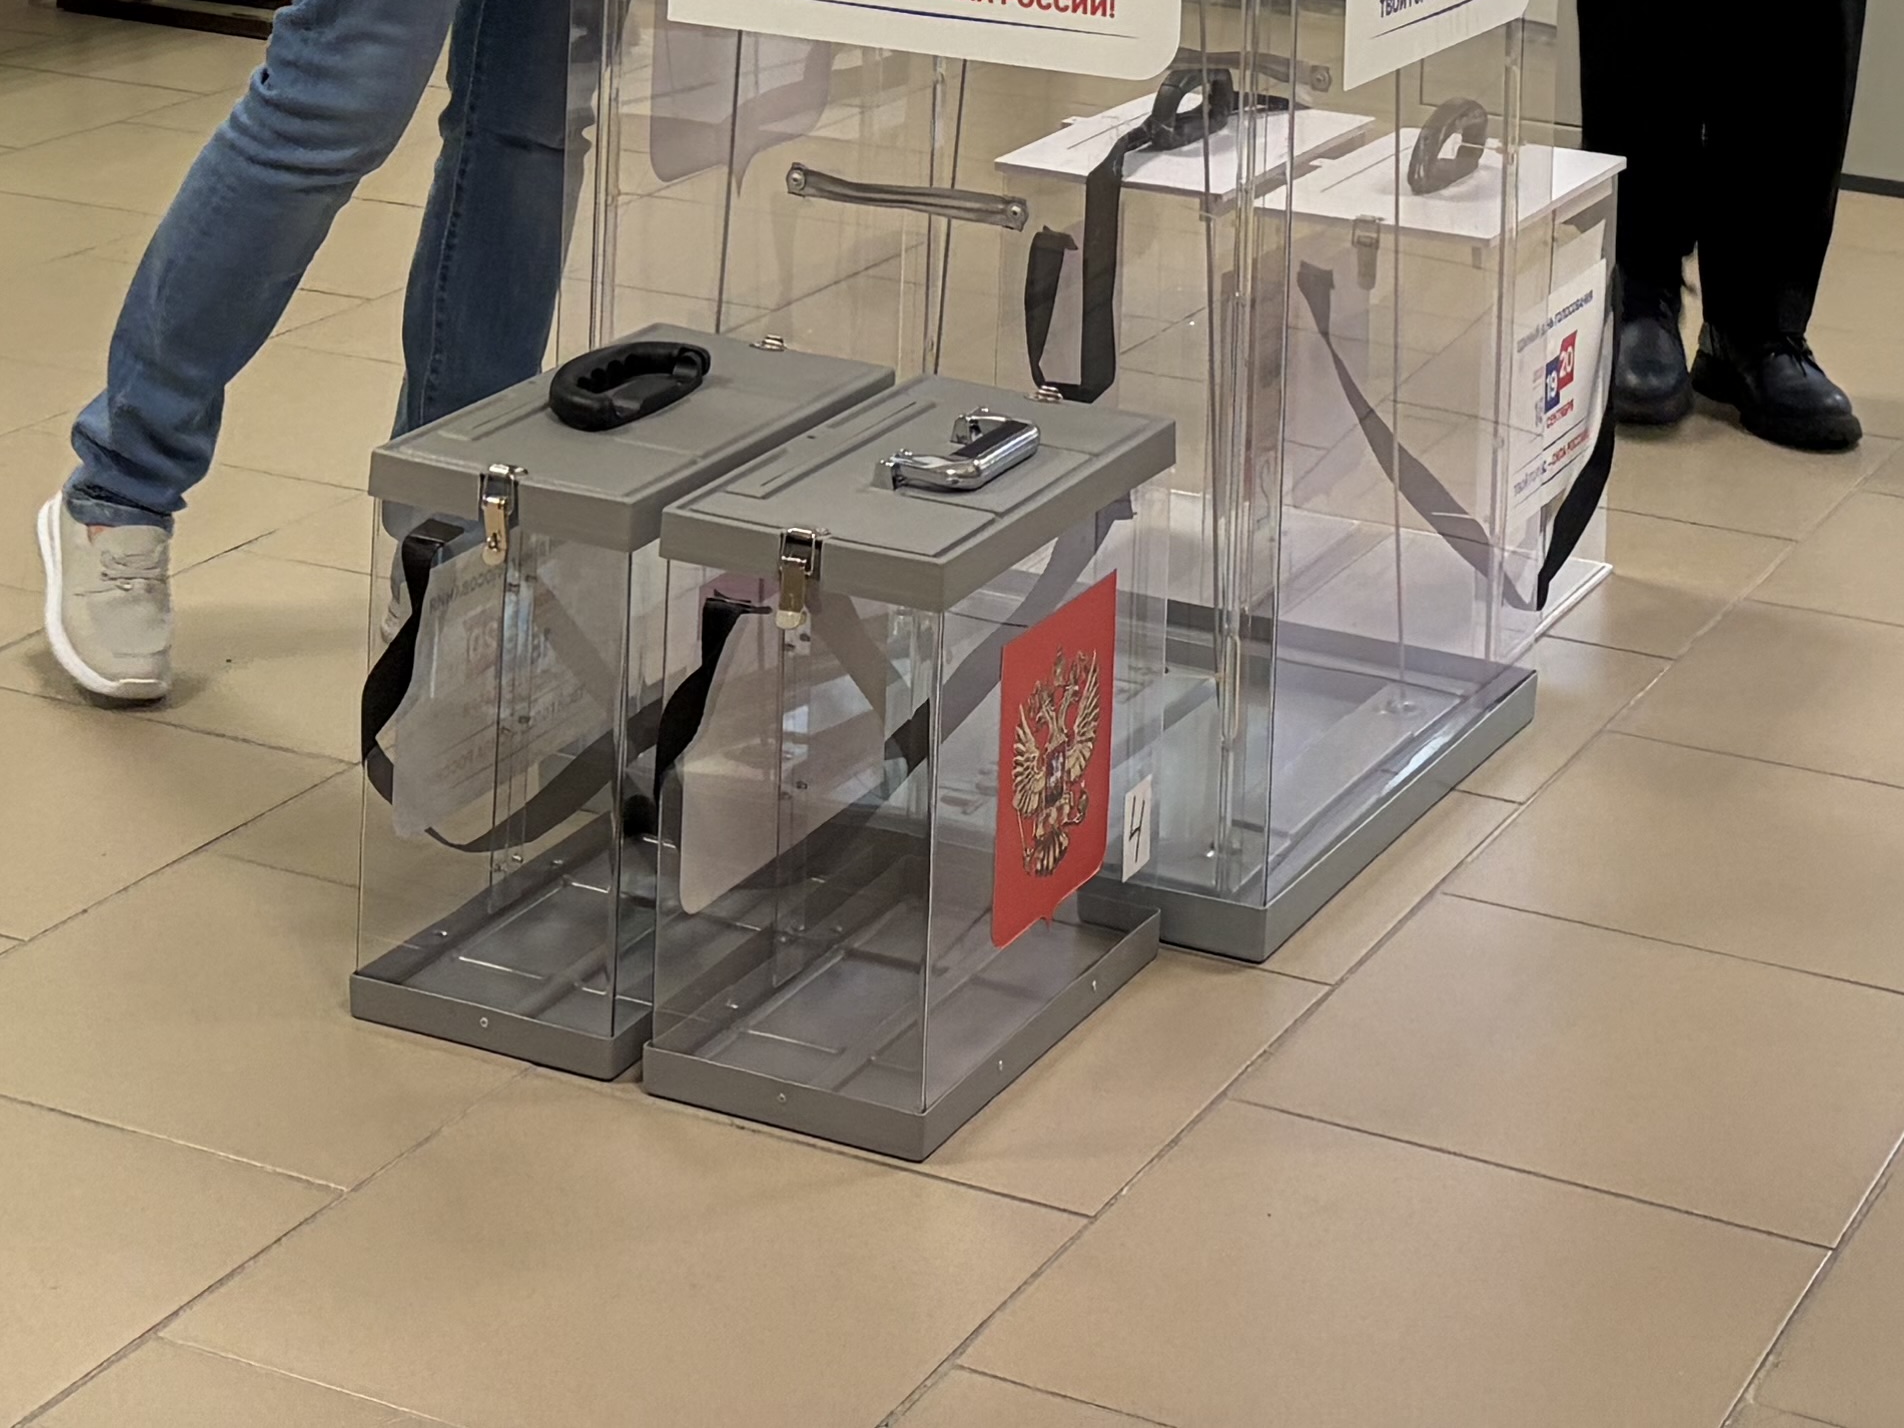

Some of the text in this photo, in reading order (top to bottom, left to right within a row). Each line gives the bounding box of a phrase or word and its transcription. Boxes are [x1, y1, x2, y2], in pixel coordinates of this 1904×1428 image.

[1546, 372, 1558, 403] 19
[1559, 346, 1573, 377] 20
[1129, 795, 1146, 864] 4
